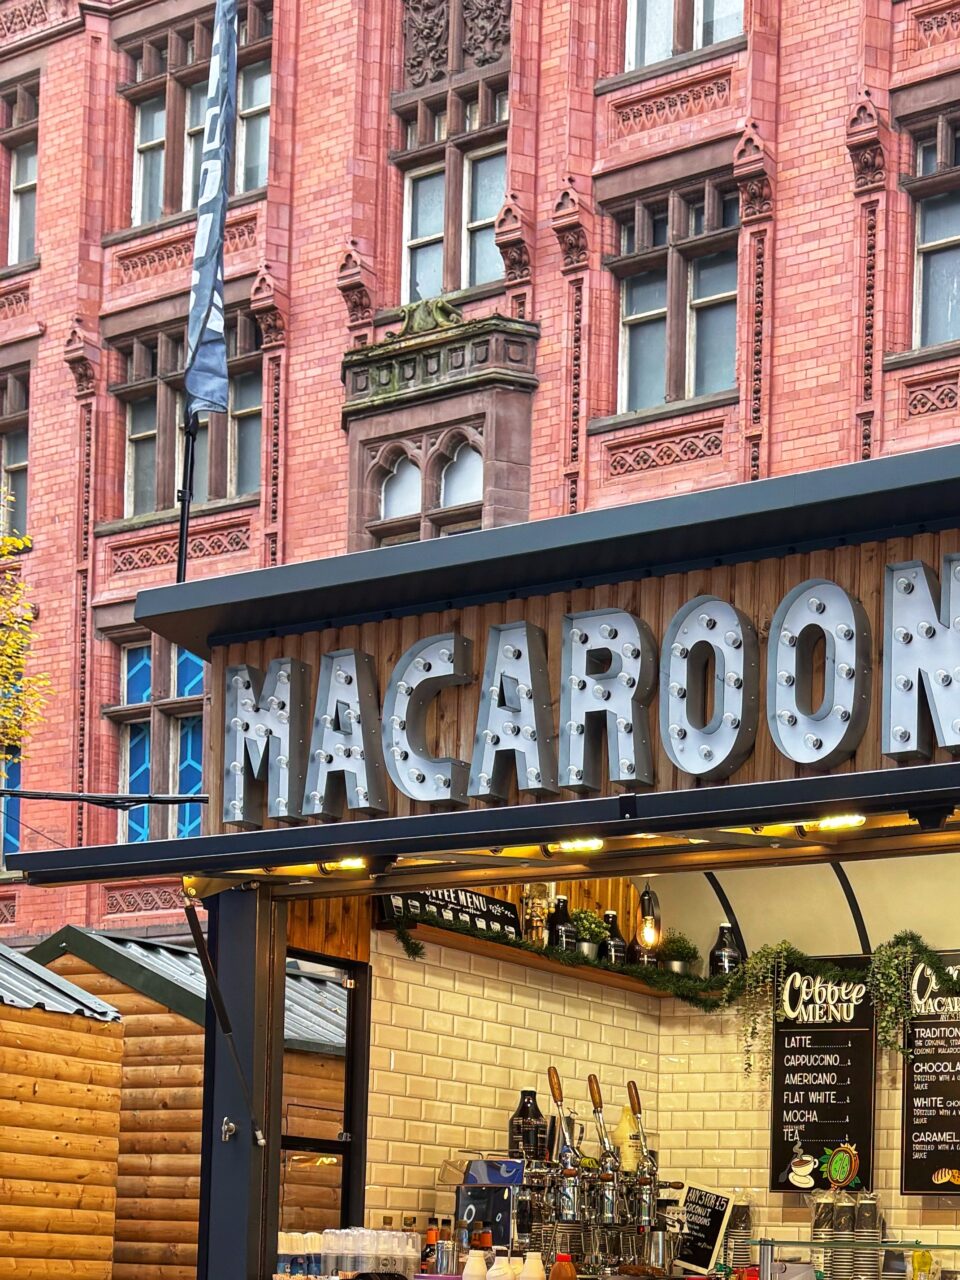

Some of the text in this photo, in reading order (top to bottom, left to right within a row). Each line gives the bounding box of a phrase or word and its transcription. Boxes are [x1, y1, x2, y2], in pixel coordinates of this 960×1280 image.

[458, 889, 487, 912] MENU
[797, 1003, 855, 1024] MENU
[785, 1036, 812, 1048] LATTE
[914, 1047, 935, 1055] COCONUT
[784, 1055, 840, 1066] CAPPUCCINO
[784, 1073, 837, 1085] AMERICANO
[783, 1091, 836, 1103] FLAT WHITE
[913, 1097, 944, 1107] WHITE
[783, 1110, 818, 1122] MOCHA
[783, 1130, 800, 1141] TEA
[912, 1131, 960, 1142] CARAMEL
[687, 1189, 701, 1203] ANY
[704, 1194, 716, 1208] FOR
